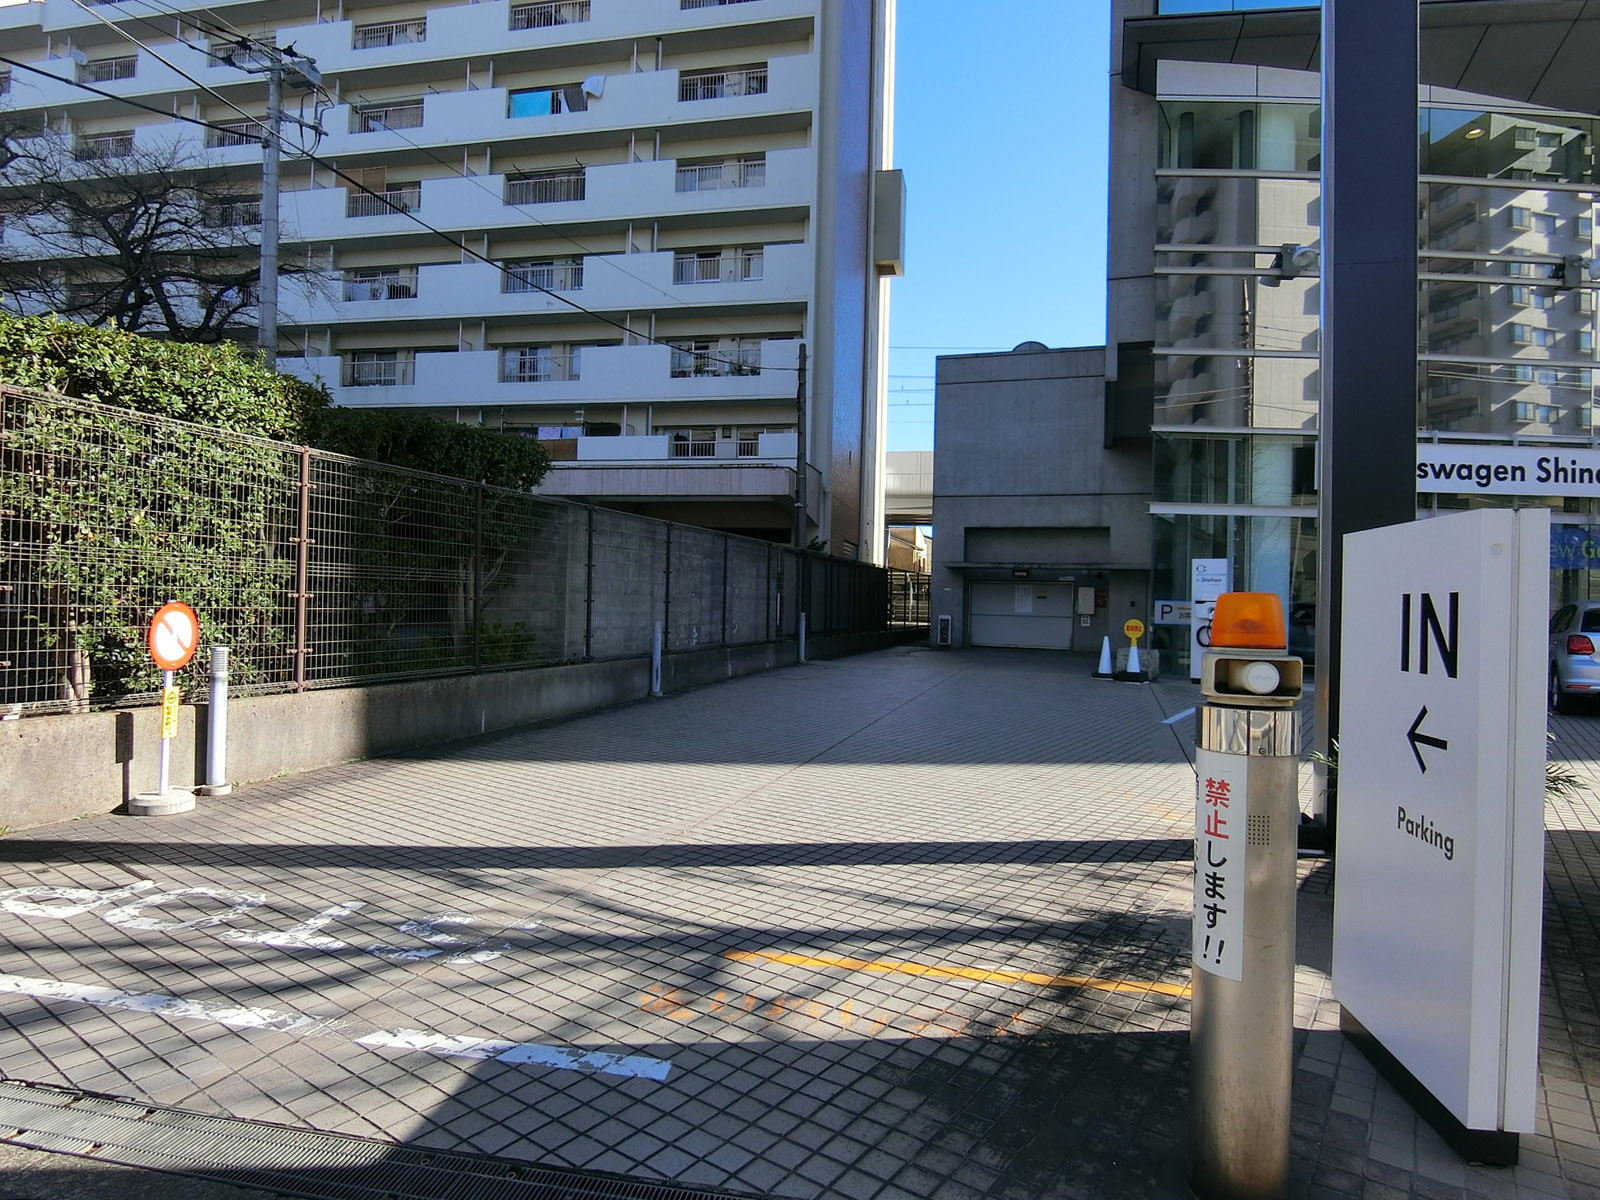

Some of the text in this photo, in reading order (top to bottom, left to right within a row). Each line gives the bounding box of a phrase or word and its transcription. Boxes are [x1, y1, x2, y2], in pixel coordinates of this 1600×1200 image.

[1416, 456, 1600, 488] swagen Shin
[1160, 604, 1173, 621] P
[1400, 591, 1459, 679] IN
[1397, 806, 1455, 861] Parking
